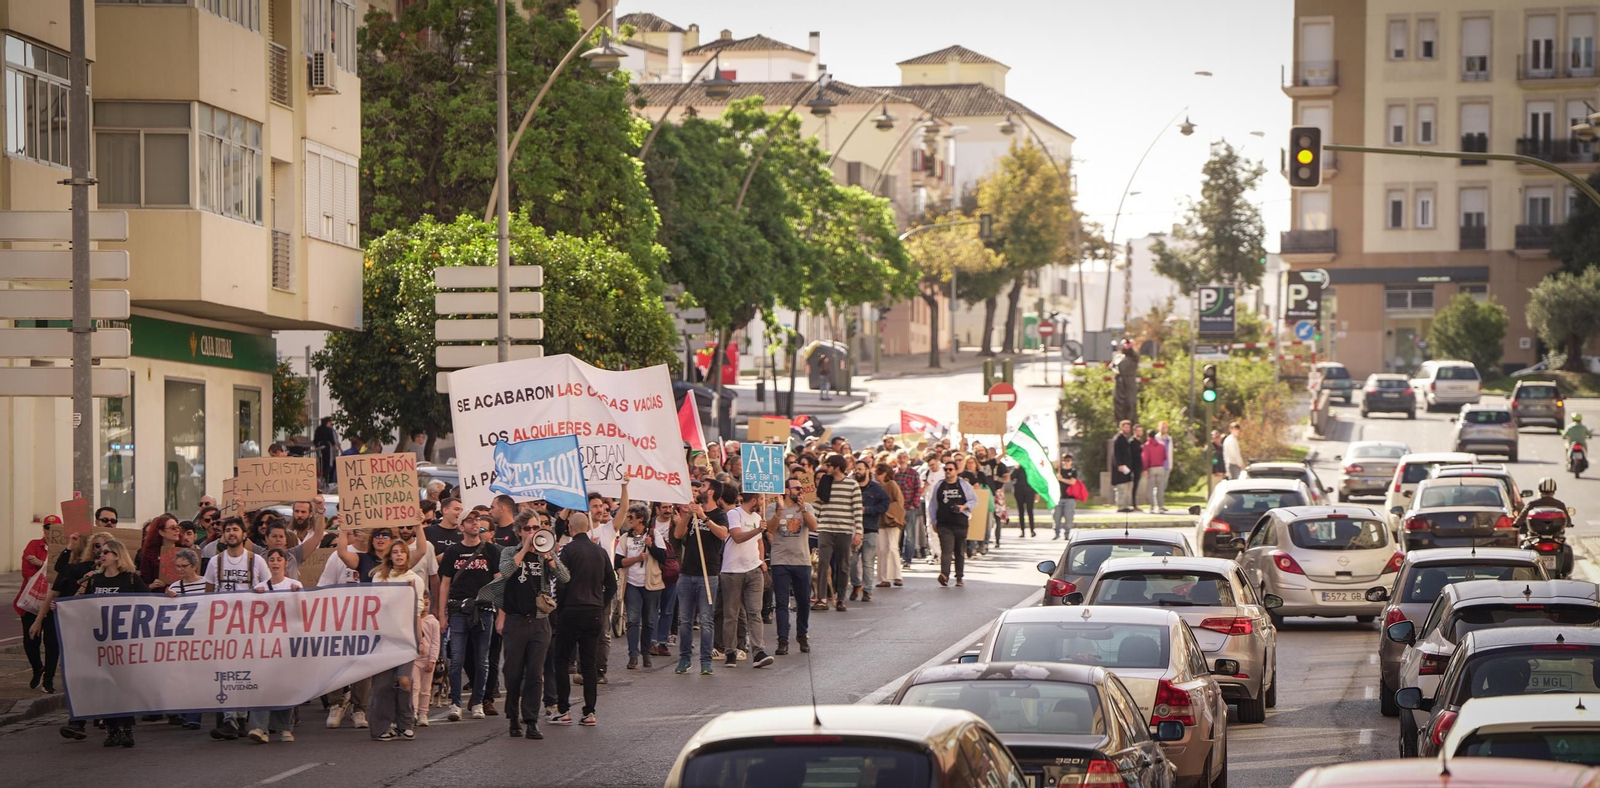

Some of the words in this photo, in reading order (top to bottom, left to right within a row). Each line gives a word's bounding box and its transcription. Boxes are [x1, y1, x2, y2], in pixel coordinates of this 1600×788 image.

[1200, 289, 1217, 311] P
[1287, 284, 1308, 310] P
[201, 335, 214, 357] CAJA
[215, 337, 233, 359] RURAL
[457, 398, 471, 412] SE
[474, 385, 554, 410] ACABARON
[557, 383, 583, 397] LAS
[479, 430, 509, 447] LOS
[586, 444, 625, 464] DEJAN
[345, 459, 367, 477] MI
[370, 455, 414, 474] RIÑÓN
[581, 463, 622, 482] CASAS
[350, 477, 367, 491] PA
[371, 473, 413, 490] PAGAR
[464, 475, 478, 490] LA
[752, 481, 774, 491] CASA
[343, 496, 361, 511] LA
[364, 491, 413, 508] ENTRADA
[346, 512, 361, 525] DE
[365, 507, 382, 519] UN
[386, 505, 415, 520] PISO
[1326, 593, 1347, 601] 5572
[1351, 593, 1366, 601] GB
[93, 602, 198, 641] JEREZ
[208, 600, 288, 635] PARA
[301, 596, 381, 632] VIVIR
[98, 645, 124, 667] POR
[128, 643, 148, 664] EL
[153, 639, 238, 662] DERECHO
[242, 638, 254, 659] A
[260, 637, 283, 659] LA
[214, 671, 251, 682] JEREZ
[1543, 677, 1566, 687] MGL
